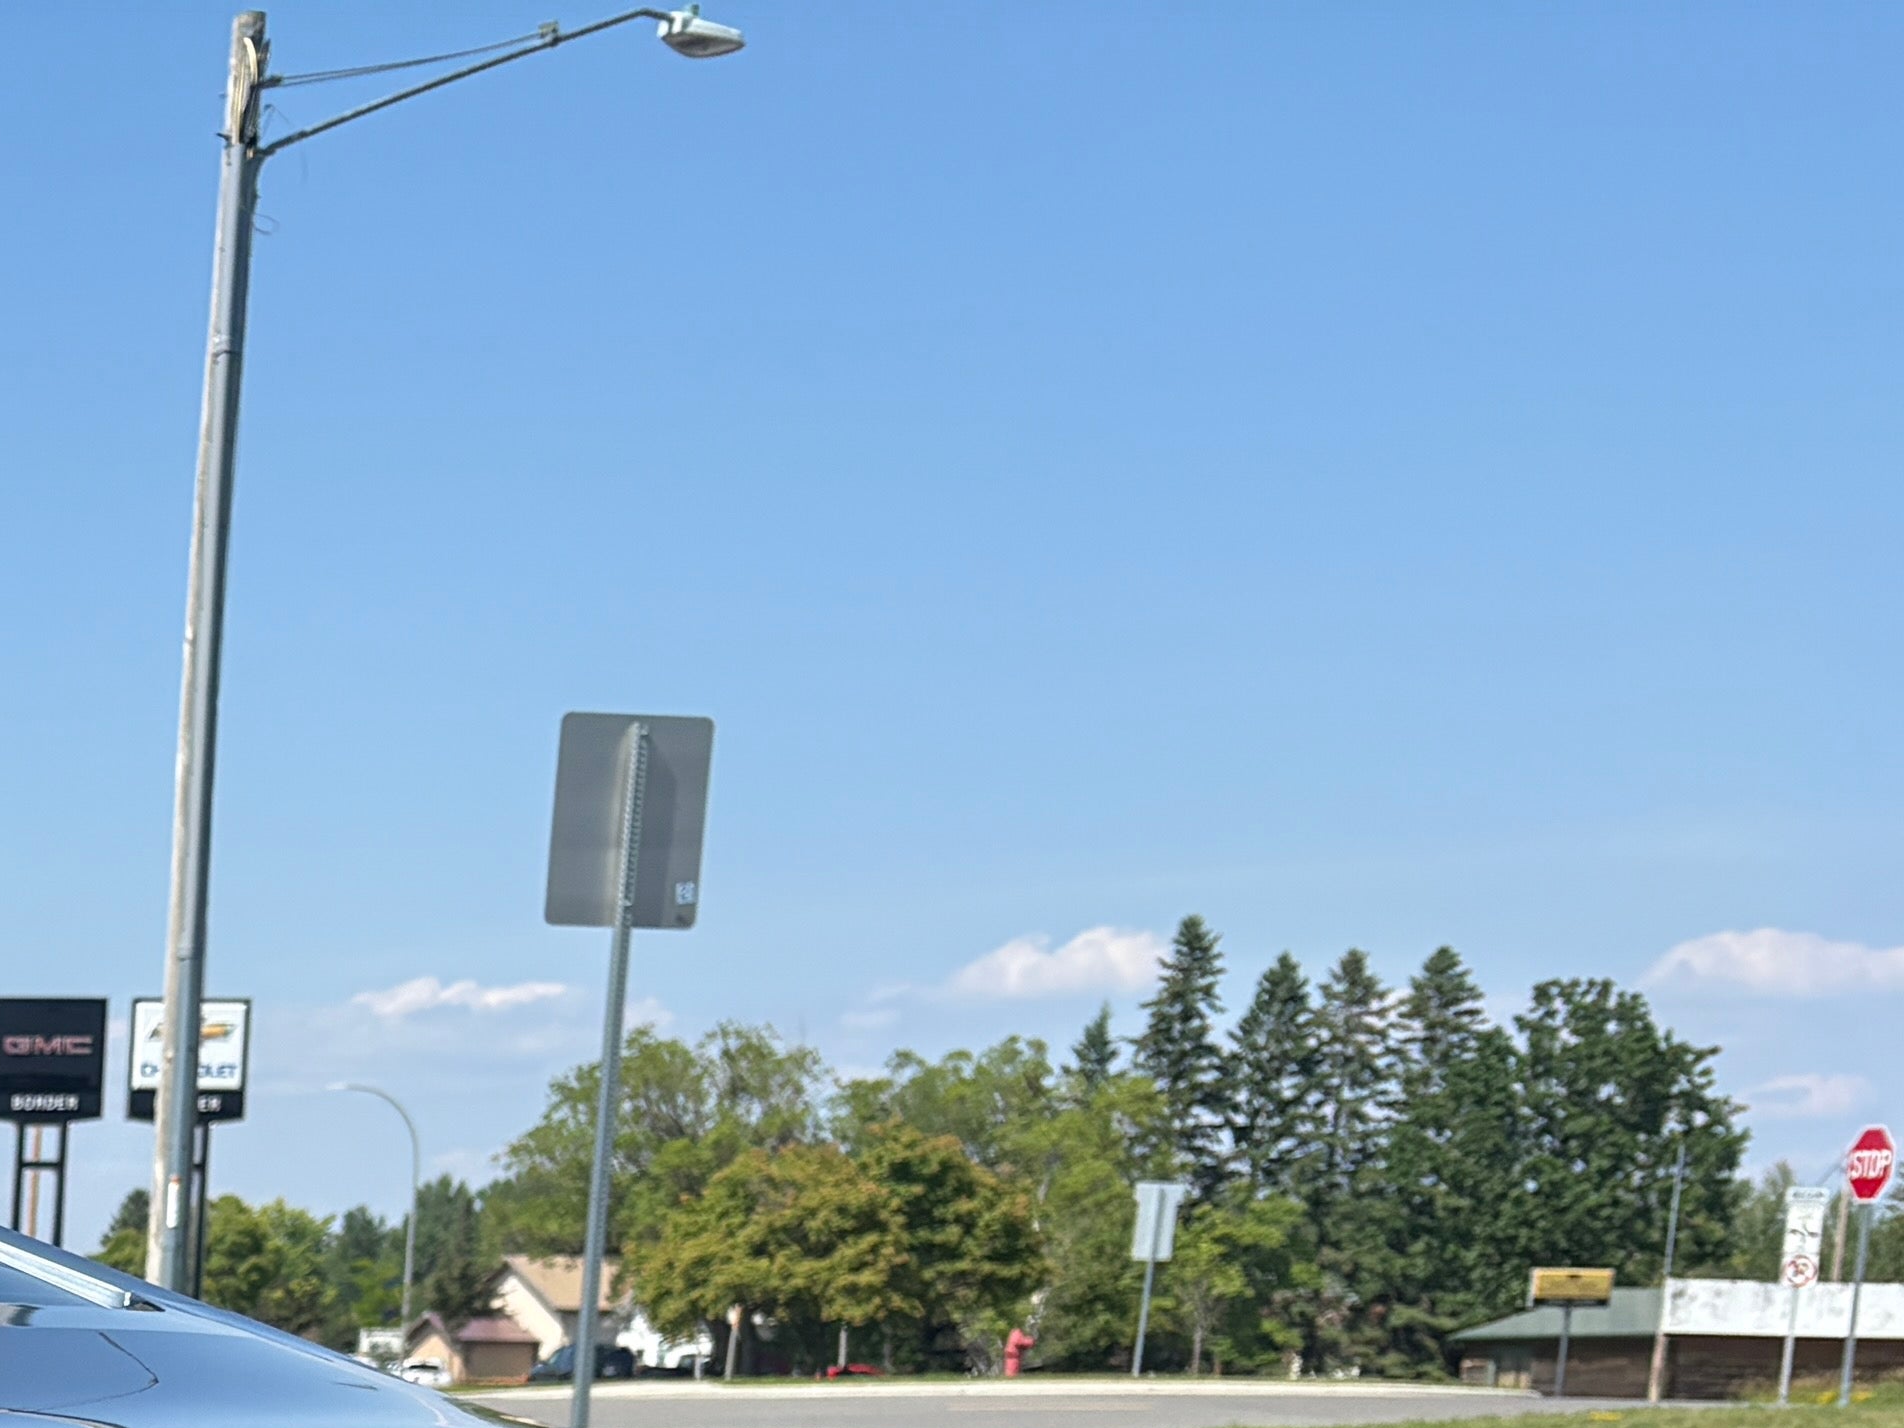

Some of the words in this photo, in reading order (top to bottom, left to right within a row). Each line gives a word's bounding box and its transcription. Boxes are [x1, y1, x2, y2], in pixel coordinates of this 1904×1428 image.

[3, 1035, 93, 1055] GMC
[140, 1063, 237, 1078] CHOLET
[11, 1094, 79, 1111] BORDER
[1851, 1150, 1892, 1178] STOP
